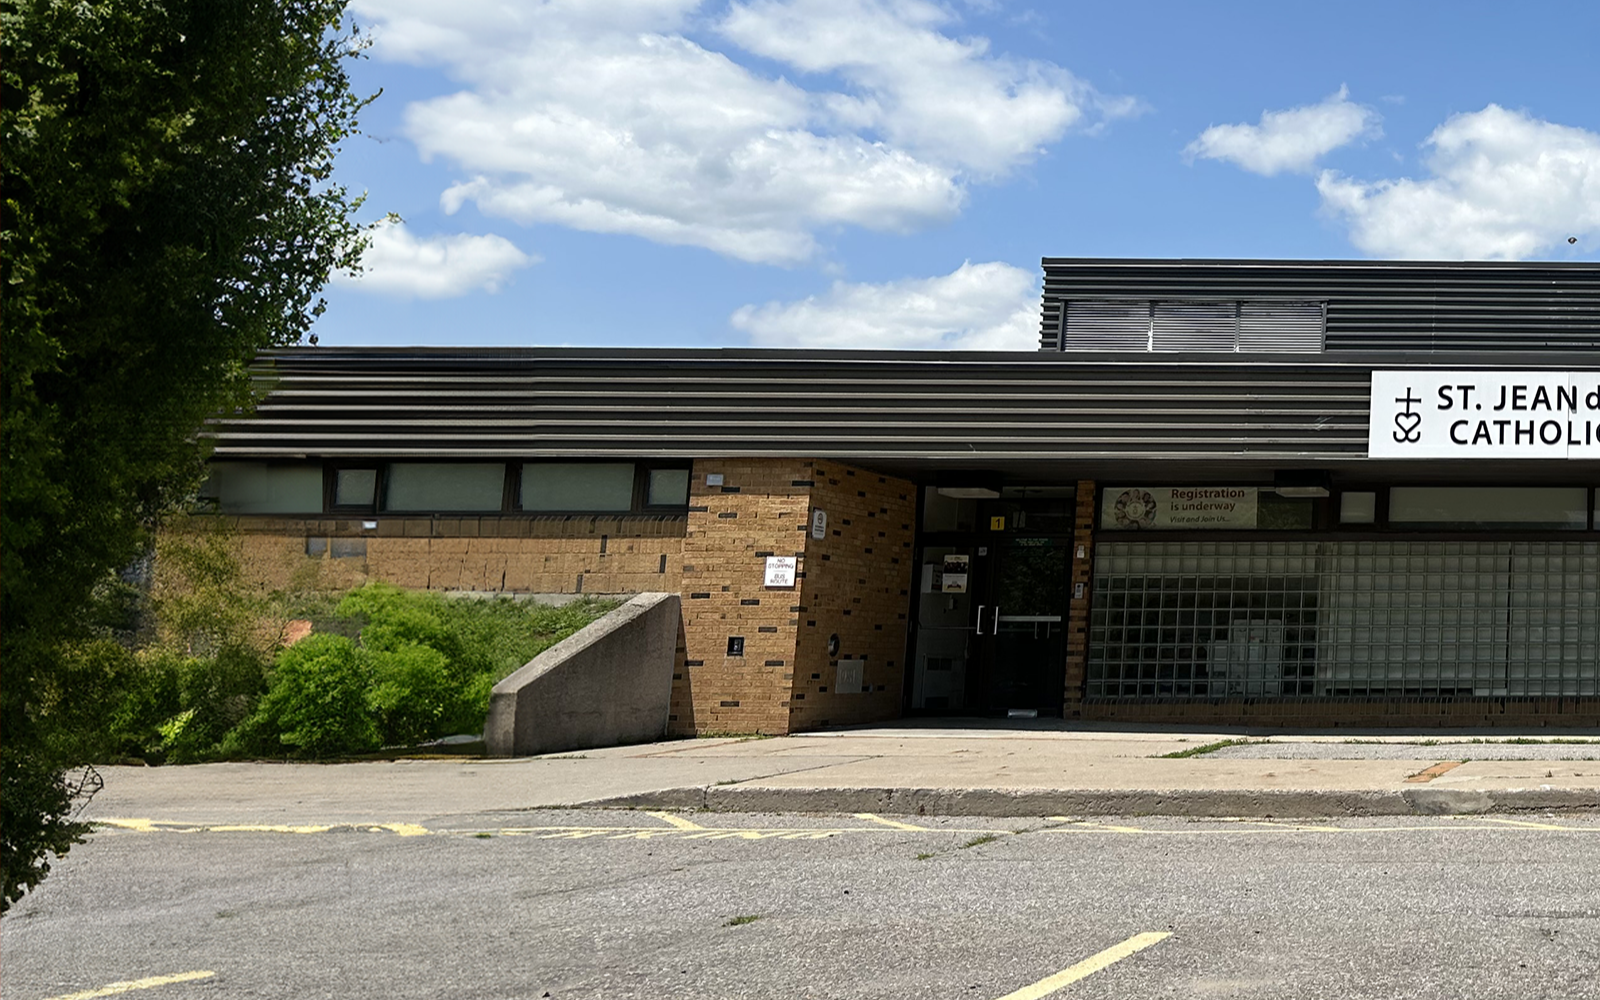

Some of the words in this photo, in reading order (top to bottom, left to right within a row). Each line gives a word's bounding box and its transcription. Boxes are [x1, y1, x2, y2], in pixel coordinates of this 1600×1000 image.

[1437, 385, 1482, 411] ST.
[1493, 385, 1578, 413] JEAN
[1171, 488, 1245, 501] Registration
[1170, 502, 1179, 511] is
[1182, 501, 1235, 512] underway
[995, 518, 1001, 529] 1
